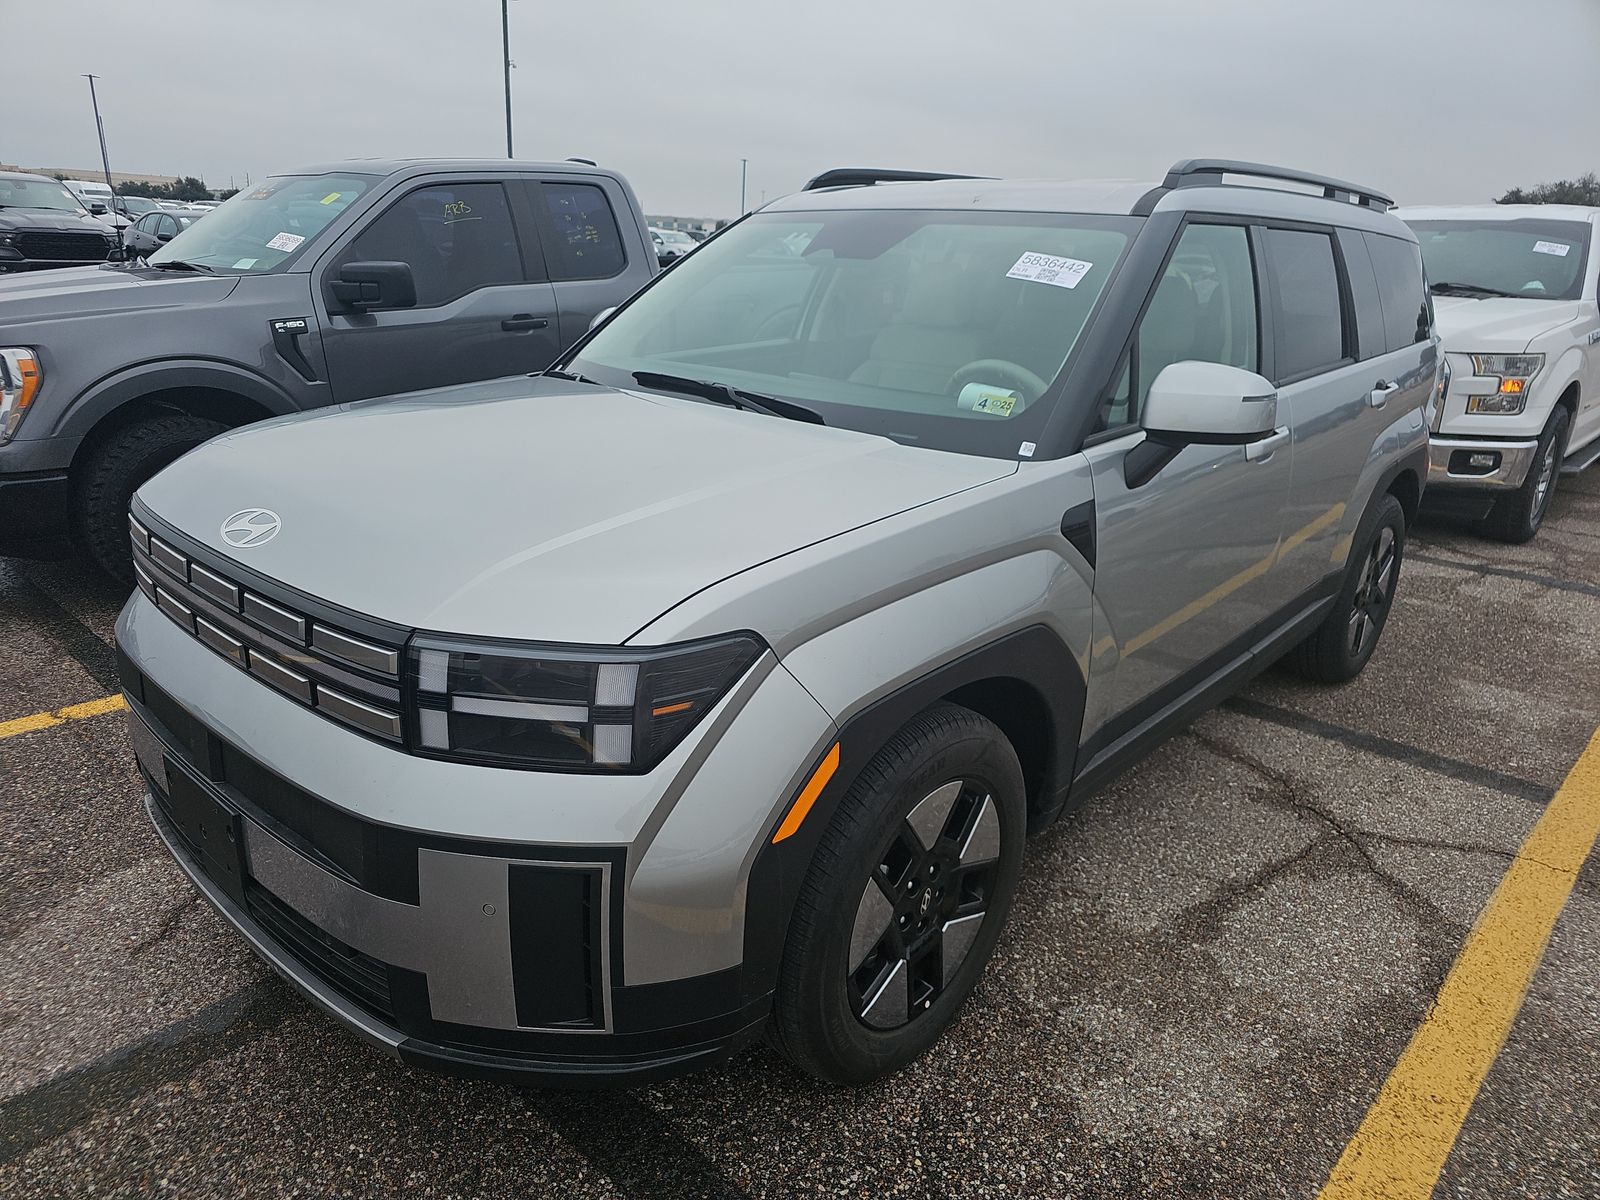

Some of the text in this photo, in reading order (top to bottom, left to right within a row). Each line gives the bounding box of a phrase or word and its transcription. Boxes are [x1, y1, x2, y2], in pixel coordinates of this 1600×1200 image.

[1022, 254, 1085, 274] 5836442
[275, 320, 305, 329] F-150
[978, 398, 1013, 411] 4 25
